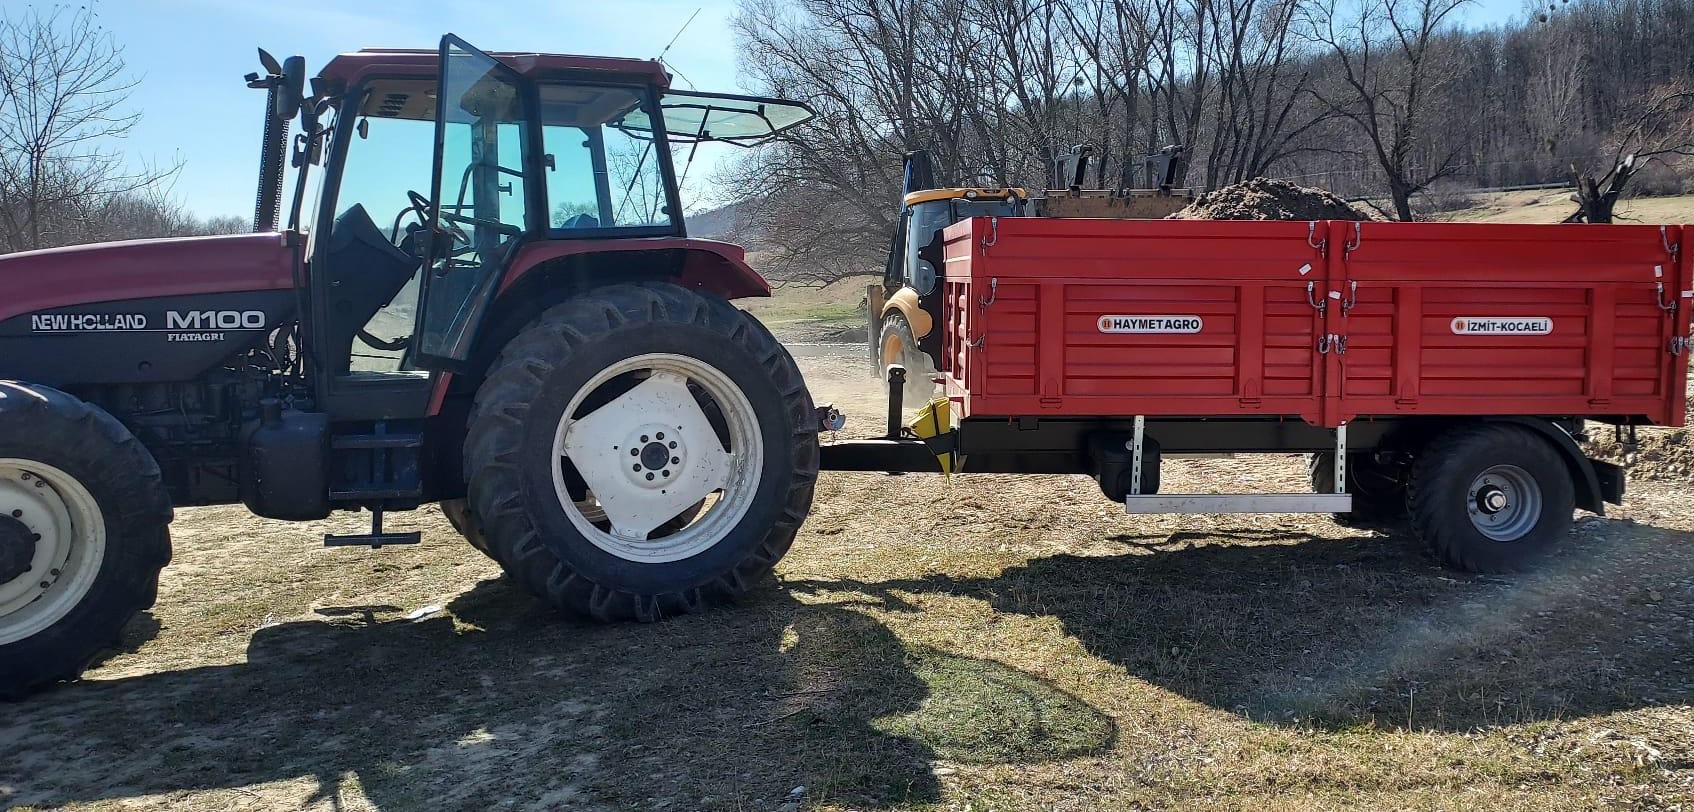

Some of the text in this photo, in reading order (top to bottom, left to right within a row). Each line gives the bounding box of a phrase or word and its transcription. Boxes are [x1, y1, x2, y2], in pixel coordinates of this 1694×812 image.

[32, 315, 146, 329] NEW HOLLAND
[166, 311, 265, 329] M100
[1467, 320, 1548, 332] İZMİT-KOCAELİ
[167, 333, 224, 341] FIATAGRI
